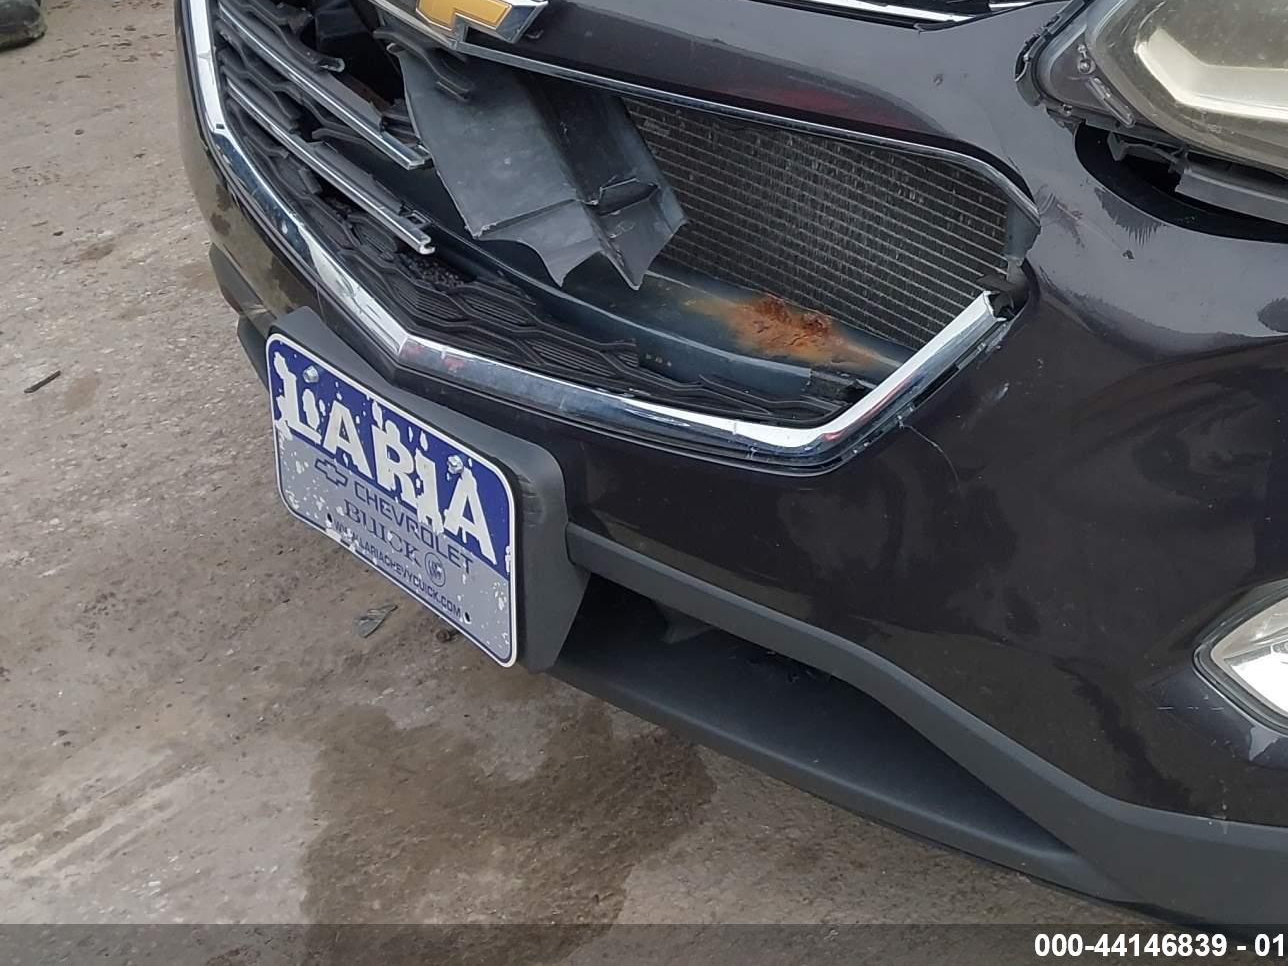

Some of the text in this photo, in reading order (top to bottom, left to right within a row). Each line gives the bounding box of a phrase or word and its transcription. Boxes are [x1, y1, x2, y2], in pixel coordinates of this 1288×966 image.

[273, 352, 497, 565] LARIA
[344, 499, 422, 567] BUICK
[354, 481, 474, 574] CHEVROLET
